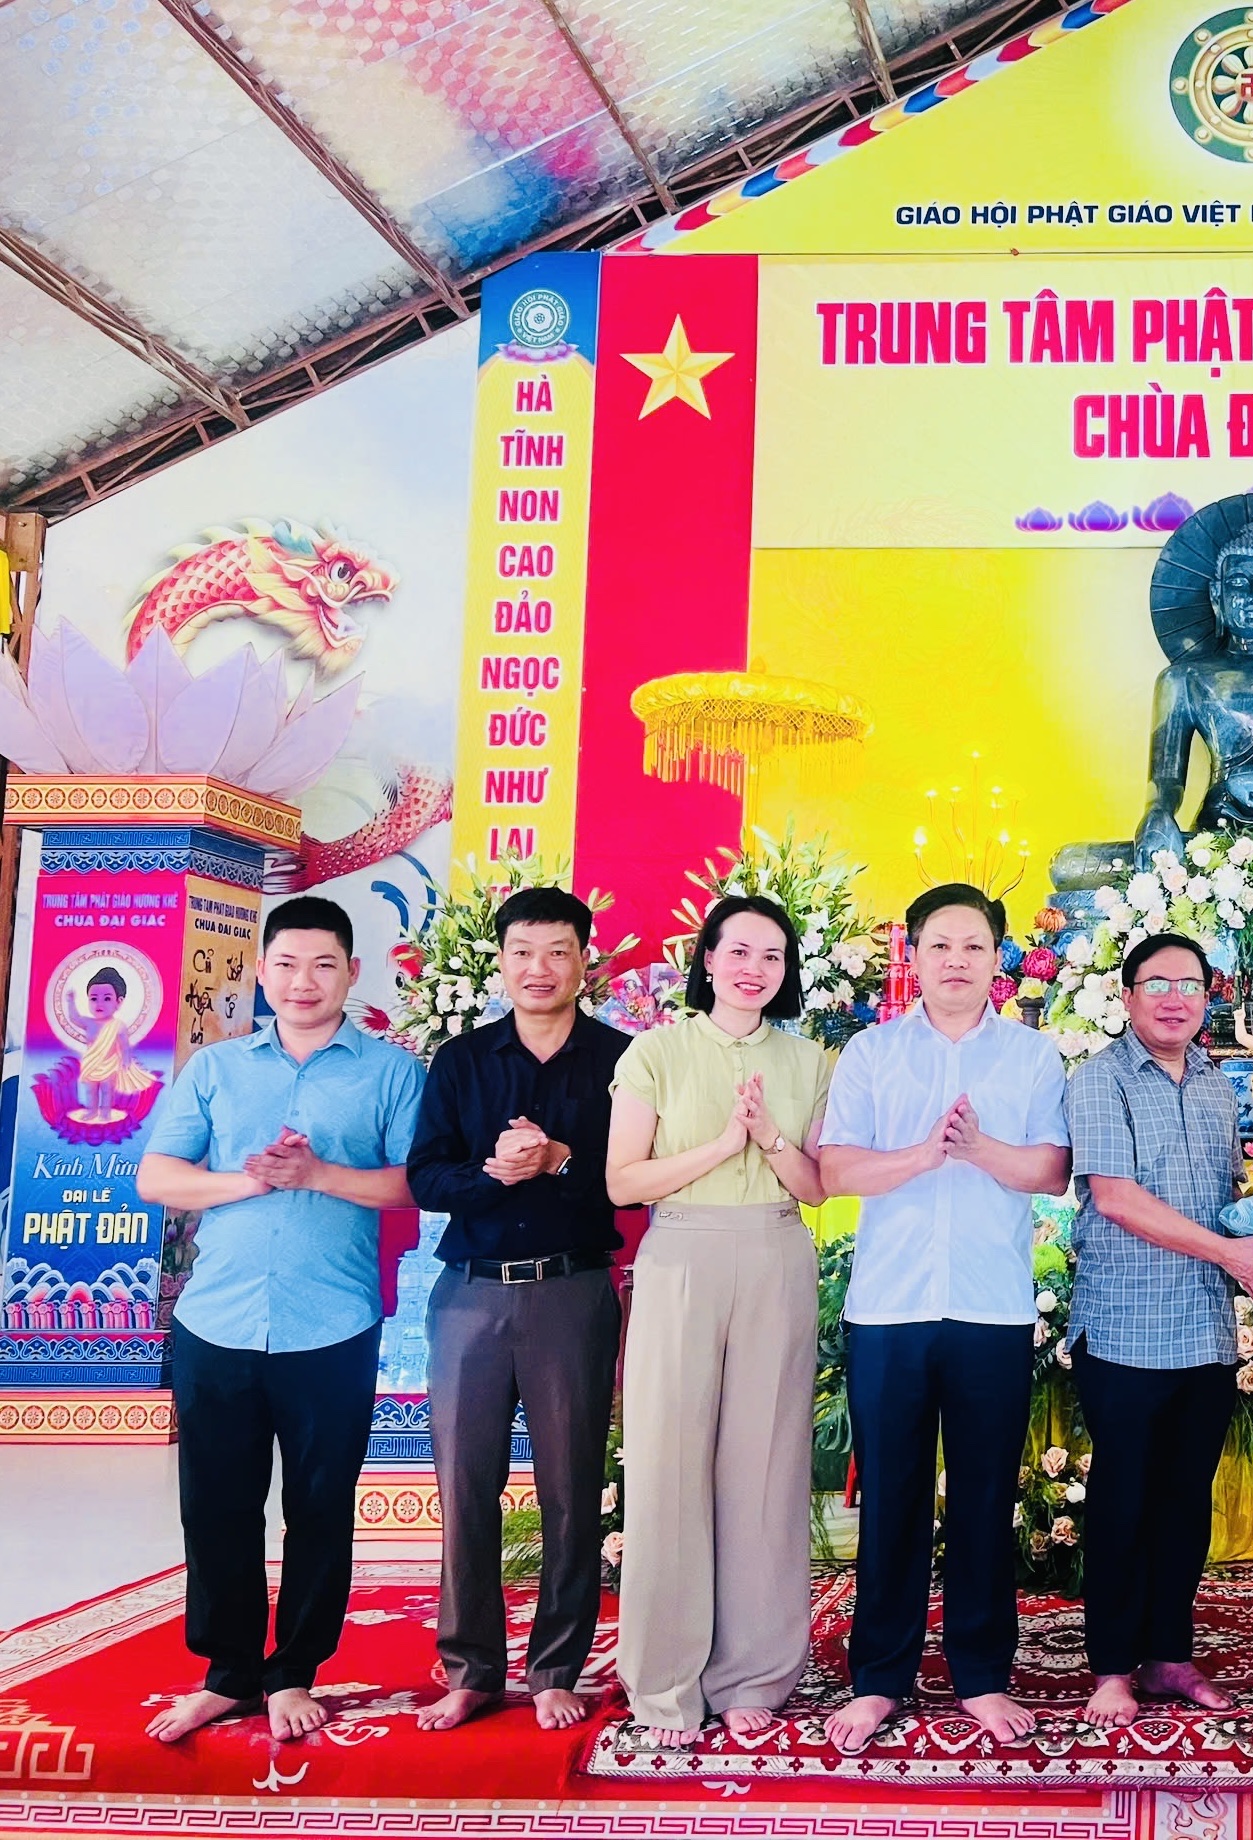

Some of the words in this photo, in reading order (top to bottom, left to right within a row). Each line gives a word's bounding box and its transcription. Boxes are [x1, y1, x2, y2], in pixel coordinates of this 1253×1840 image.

[896, 201, 960, 225] GIÁO
[971, 201, 1017, 228] HỘI
[1027, 201, 1099, 227] PHẬT
[1108, 200, 1173, 223] GIÁO
[1182, 200, 1241, 227] VIỆT
[816, 301, 987, 365] TRUNG
[1002, 288, 1114, 363] TÂM
[516, 374, 553, 412] HÀ
[1073, 382, 1210, 458] CHÙA
[500, 429, 564, 467] TĨNH
[498, 490, 559, 522] NON
[498, 545, 554, 577] CAO
[494, 590, 551, 633] ĐẢO
[481, 657, 560, 697] NGỌC
[488, 707, 546, 746] ĐỨC
[485, 767, 549, 803] NHƯ
[490, 828, 534, 861] LAI
[32, 1152, 83, 1179] Kính
[87, 1152, 139, 1179] Mừn
[62, 1190, 87, 1205] ĐẠI
[92, 1187, 115, 1203] LỄ
[23, 1209, 92, 1250] PHẬT
[95, 1203, 149, 1244] ĐẢN
